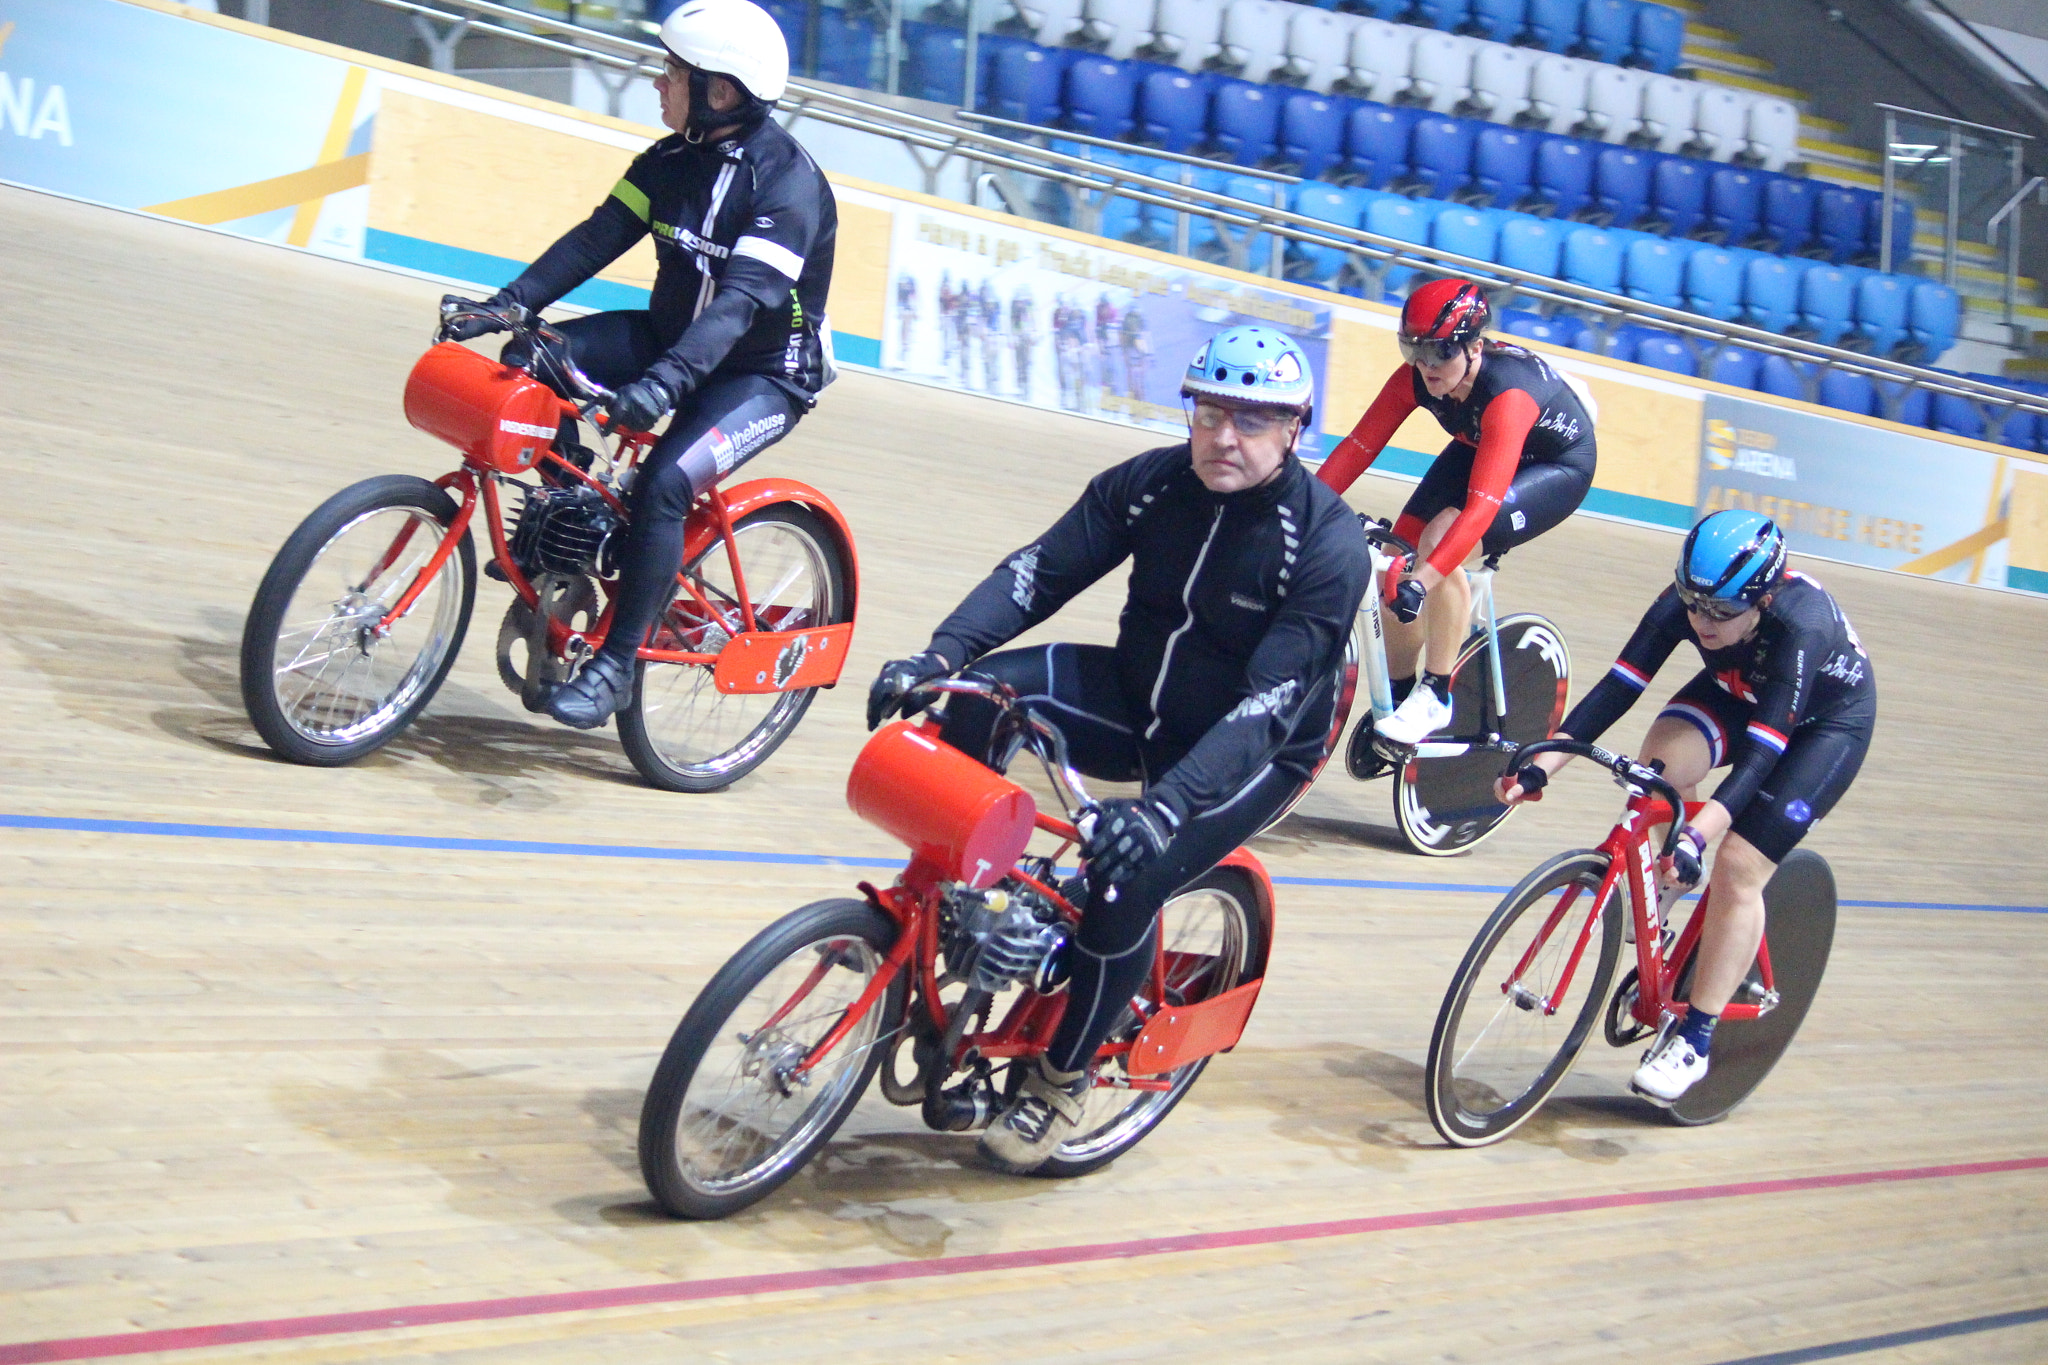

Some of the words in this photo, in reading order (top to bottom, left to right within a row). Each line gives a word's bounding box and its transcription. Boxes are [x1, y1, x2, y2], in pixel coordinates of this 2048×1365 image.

[1690, 574, 1714, 587] GIRO
[1796, 649, 1805, 676] BORN
[1795, 677, 1803, 689] TO
